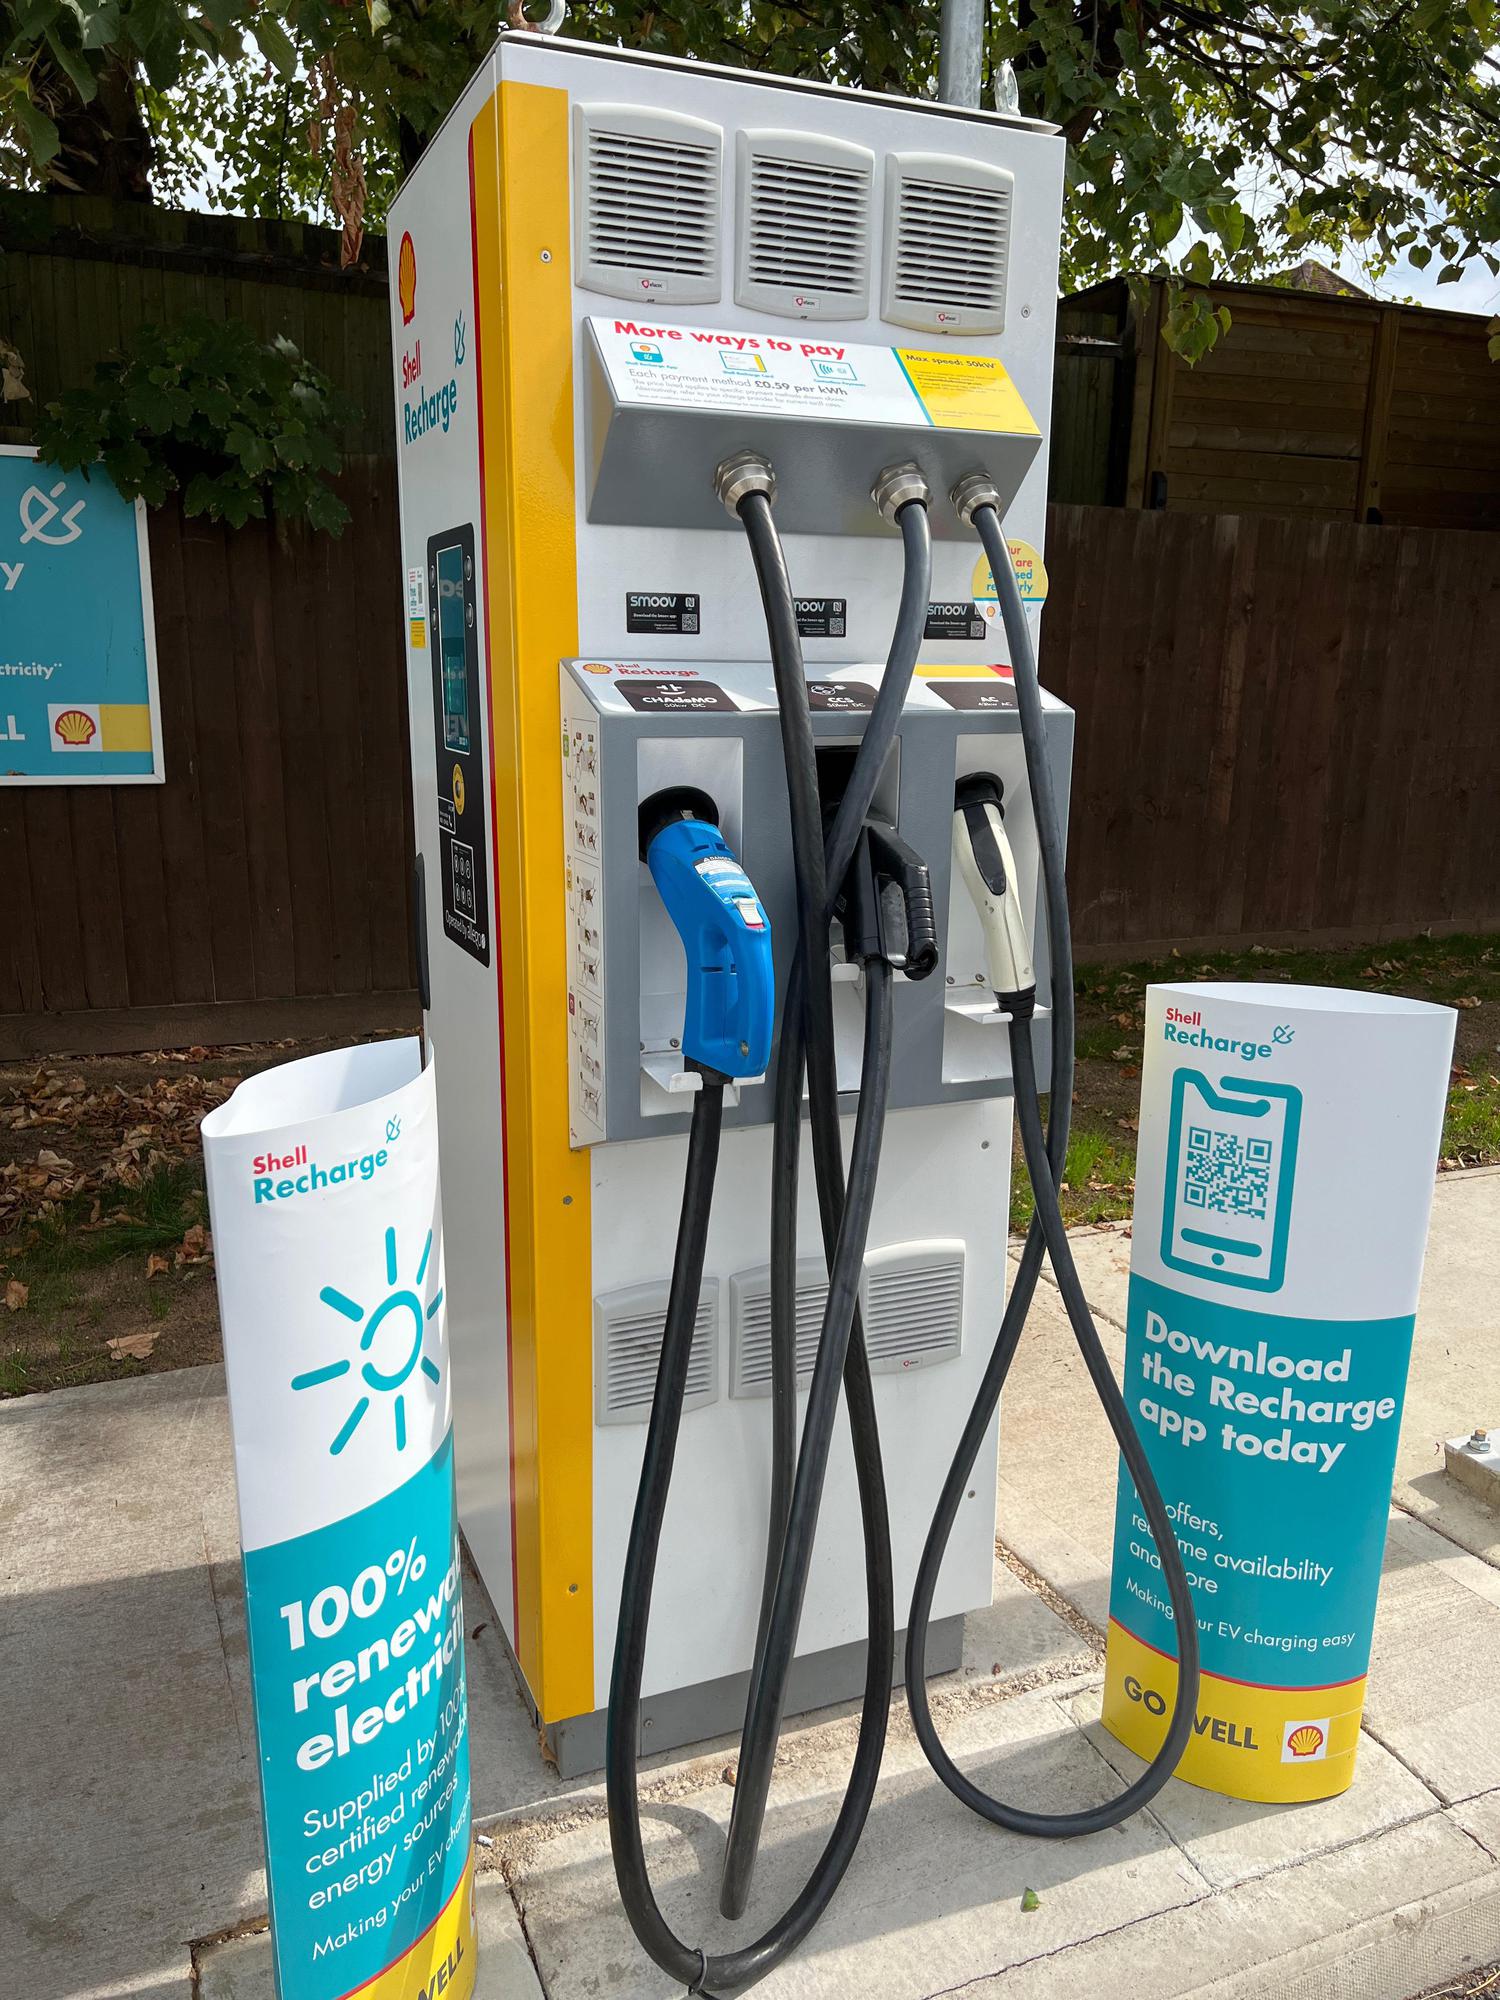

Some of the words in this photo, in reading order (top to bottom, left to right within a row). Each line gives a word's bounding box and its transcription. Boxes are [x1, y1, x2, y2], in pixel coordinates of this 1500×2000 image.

[614, 321, 682, 340] More
[690, 332, 760, 350] ways
[767, 338, 792, 351] to
[800, 344, 845, 360] pay
[906, 354, 928, 362] Max
[932, 358, 963, 366] speed:
[403, 339, 421, 389] Shell
[629, 368, 657, 379] Each
[660, 372, 708, 384] payment
[711, 376, 751, 387] method
[755, 380, 790, 390] £0.59
[794, 385, 815, 393] per
[818, 385, 848, 395] kWh
[404, 379, 457, 445] Recharge
[630, 596, 677, 607] smoov
[794, 601, 825, 612] moov
[618, 668, 700, 677] Recharge
[1166, 1008, 1201, 1026] Shell
[1164, 1023, 1272, 1061] Recharge
[253, 1145, 307, 1175] Shell
[253, 1147, 388, 1204] Recharge
[1145, 1309, 1352, 1382] Download
[1142, 1352, 1195, 1397] the
[1209, 1375, 1395, 1431] Recharge
[1139, 1397, 1207, 1447] app
[1221, 1423, 1346, 1473] today
[1165, 1501, 1223, 1541] offers,
[1185, 1571, 1218, 1593] ore
[1214, 1552, 1334, 1587] availability
[280, 1535, 427, 1651] 100%
[1126, 1577, 1174, 1620] Making
[1218, 1621, 1241, 1639] EV
[1244, 1628, 1318, 1653] charging
[1322, 1631, 1356, 1648] easy
[1124, 1675, 1166, 1716] GO
[304, 1749, 412, 1837] Supplied
[417, 1730, 437, 1765] by
[305, 1792, 405, 1874] certified
[308, 1844, 397, 1910] energy
[403, 1771, 458, 1851] sources
[312, 1906, 387, 1961] Making
[391, 1871, 425, 1916] your
[428, 1842, 444, 1875] EV
